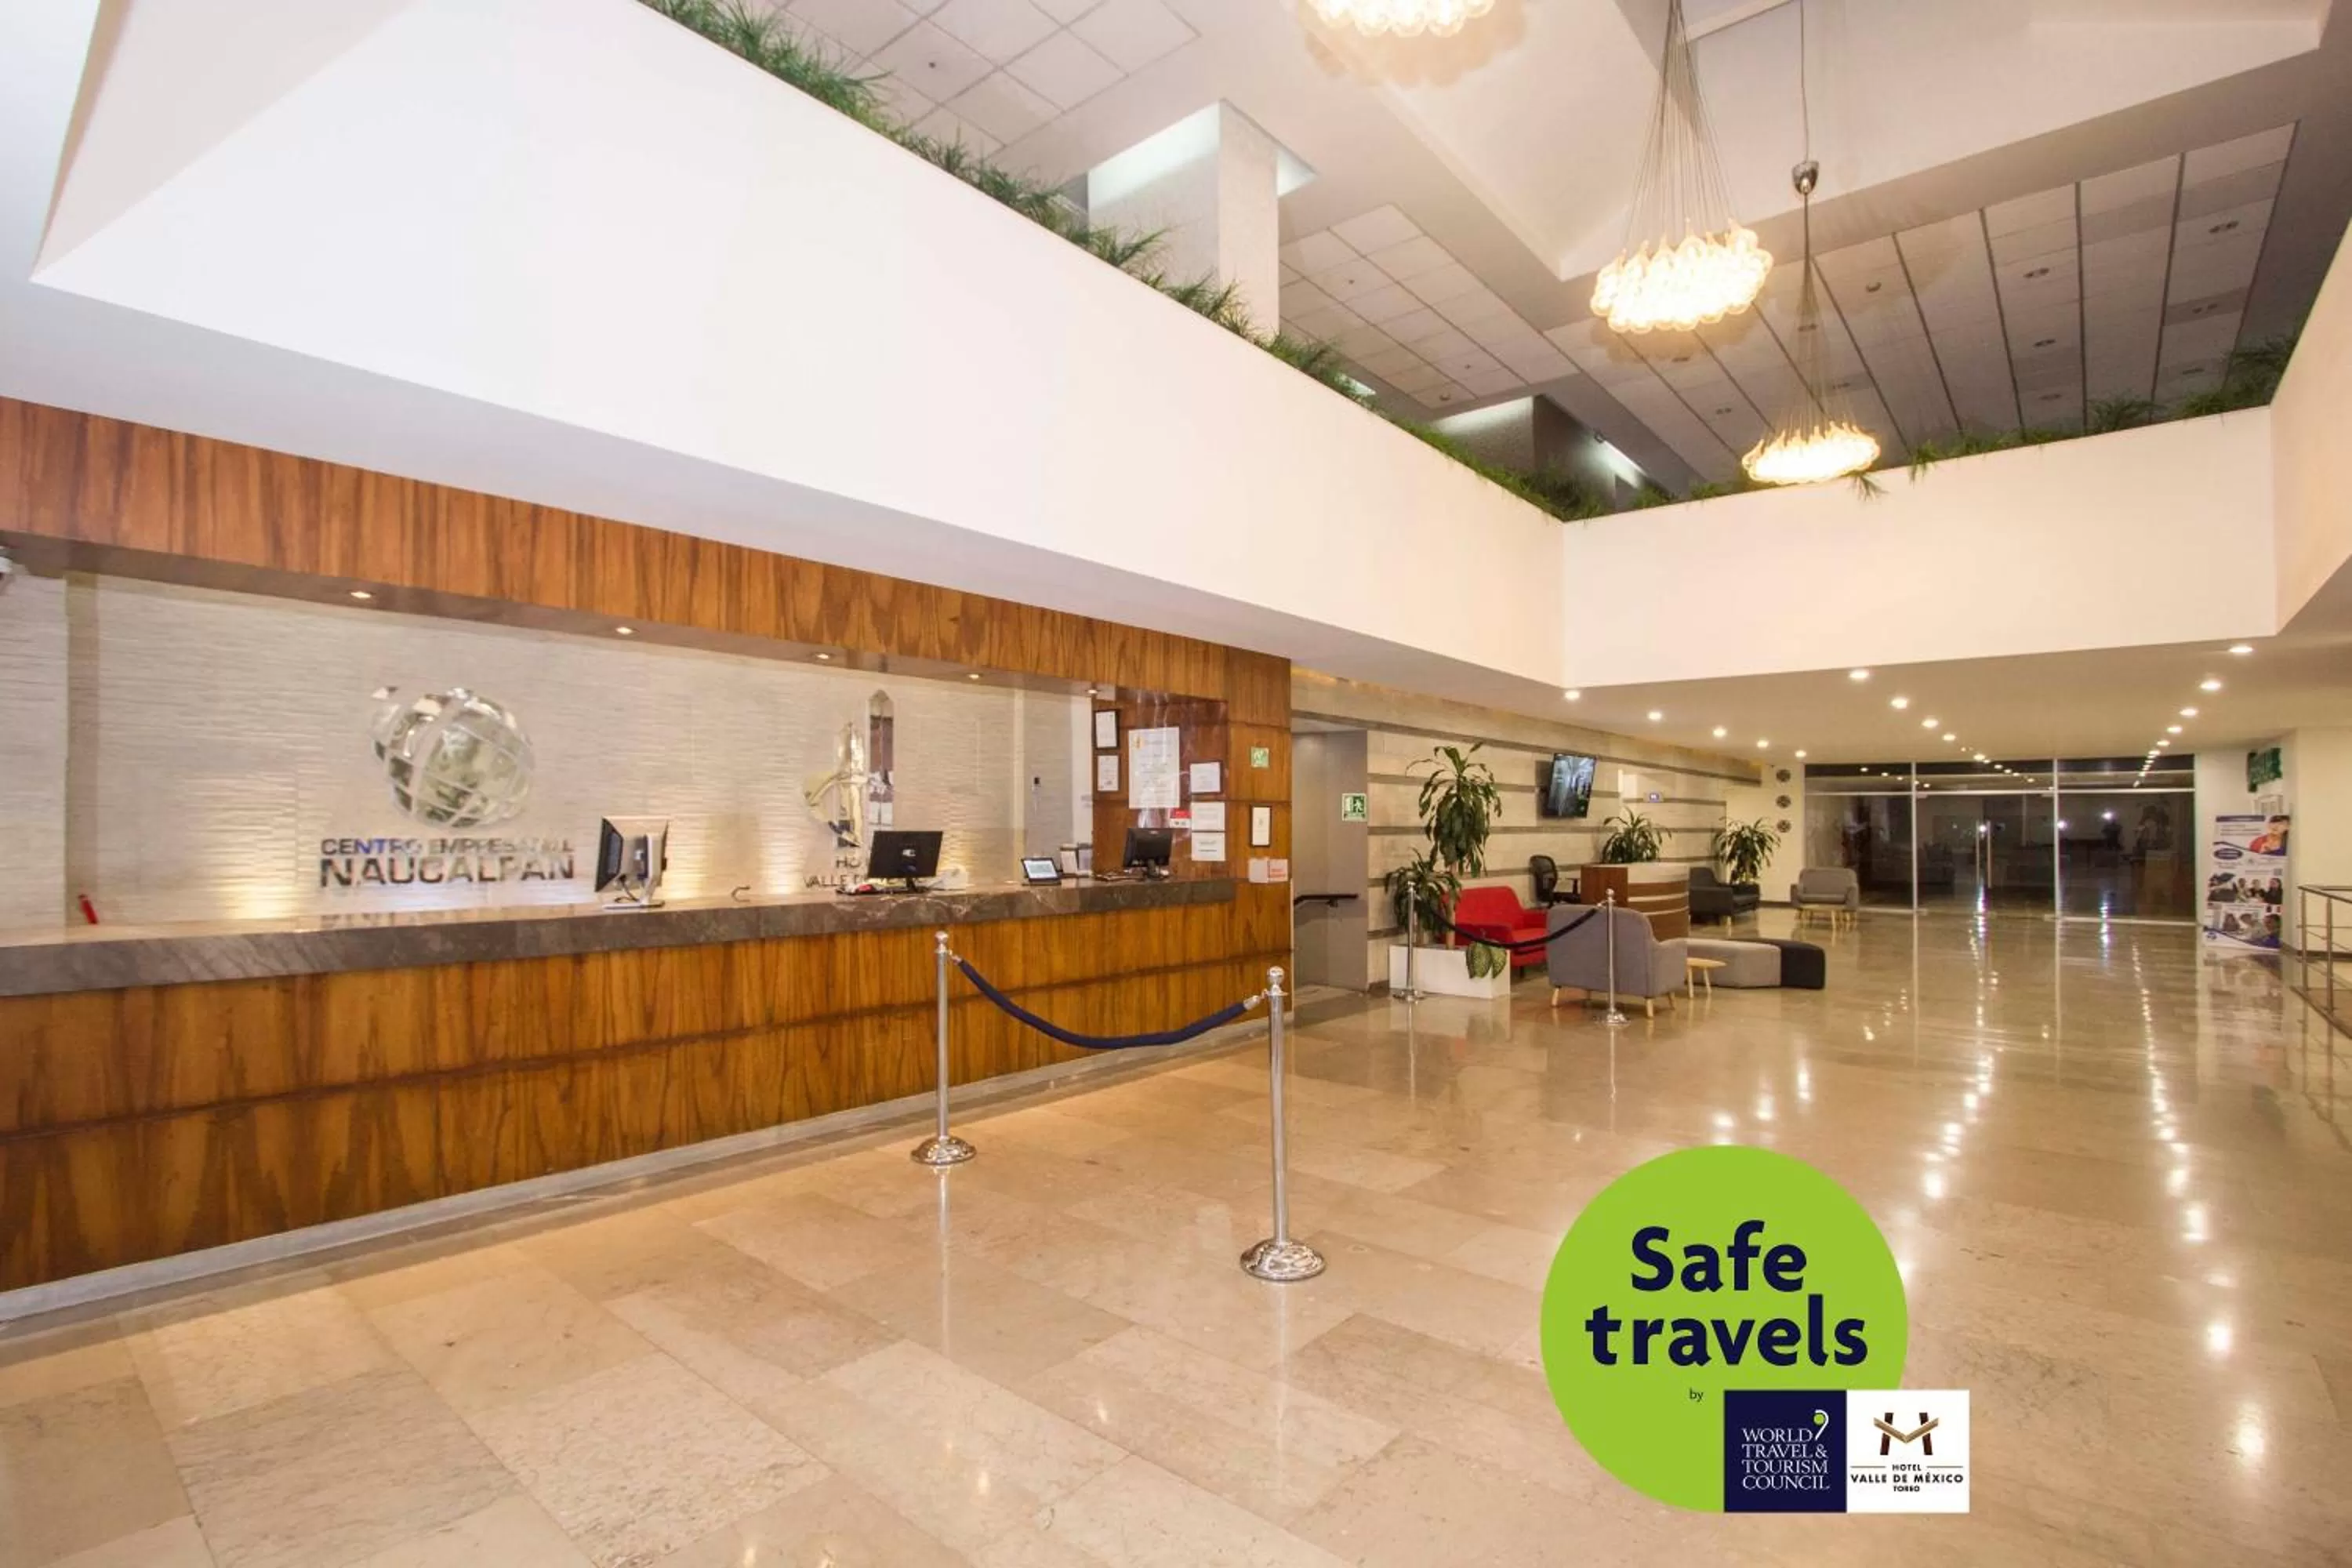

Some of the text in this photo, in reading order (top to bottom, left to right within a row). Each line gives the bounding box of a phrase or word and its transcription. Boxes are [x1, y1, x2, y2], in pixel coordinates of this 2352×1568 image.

[321, 838, 575, 855] CENTRO EMPRESL
[320, 856, 575, 887] NAUCALPAN
